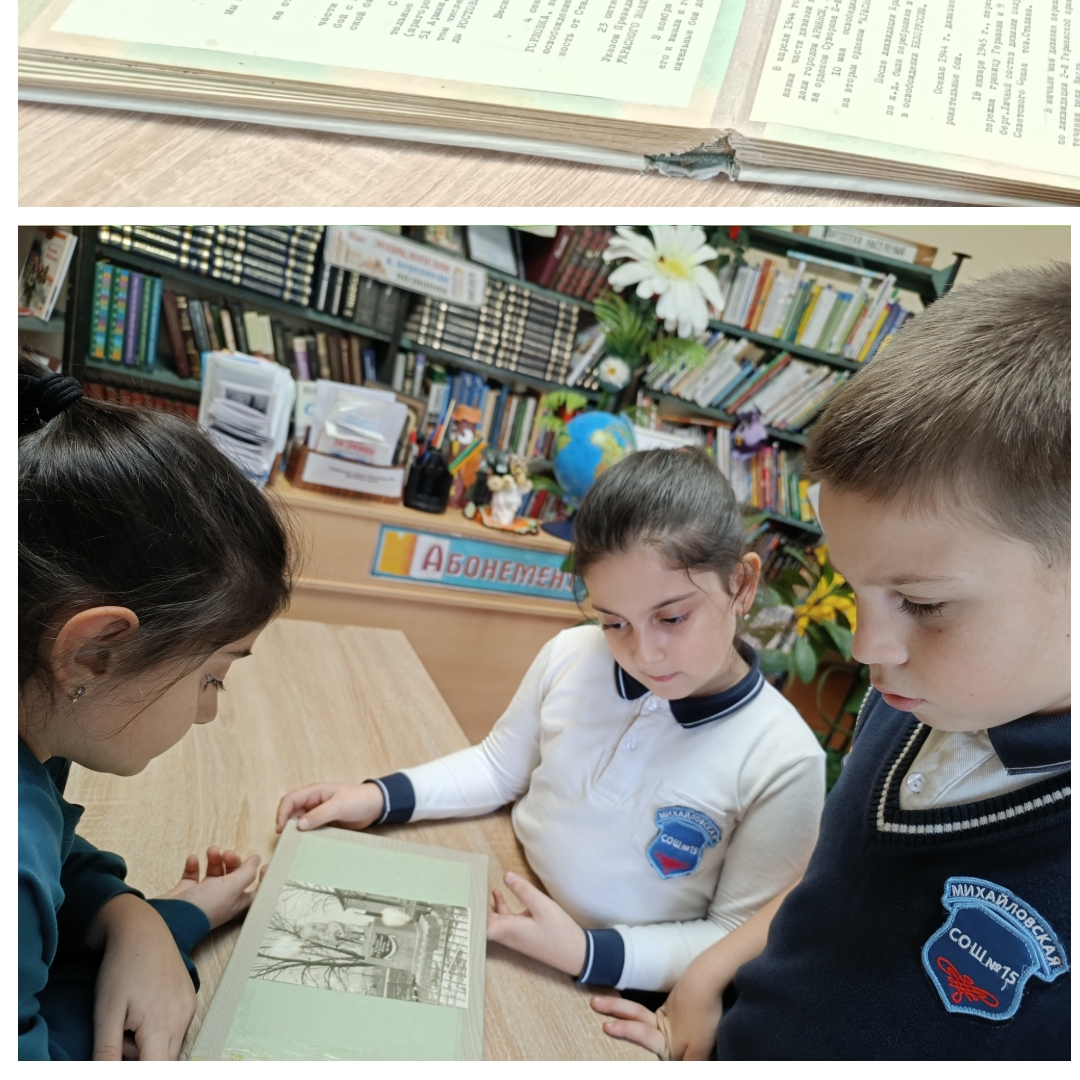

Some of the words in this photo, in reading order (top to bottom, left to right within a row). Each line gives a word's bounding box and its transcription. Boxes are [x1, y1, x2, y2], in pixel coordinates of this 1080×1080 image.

[316, 1, 339, 26] части
[331, 13, 349, 29] бой
[346, 10, 367, 31] ской
[388, 1, 415, 35] тельные
[435, 25, 450, 41] том
[557, 31, 575, 57] ность
[600, 32, 621, 62] Указом
[672, 28, 694, 71] нительные
[687, 10, 700, 26] бои
[775, 32, 791, 62] апреля
[821, 14, 839, 51] Суворова
[880, 12, 897, 57] ликвидации
[781, 71, 796, 98] ниями
[790, 38, 804, 64] части
[797, 4, 813, 37] дивизии
[802, 41, 819, 77] городом
[835, 46, 847, 63] мая
[843, 63, 858, 93] вторым
[851, 27, 866, 60] орденом
[952, 51, 962, 70] бои.
[1004, 50, 1015, 79] состав
[813, 53, 830, 88] орденом
[874, 58, 888, 84] После
[901, 51, 919, 108] освобождении
[933, 65, 946, 95] Осенью
[988, 57, 1001, 90] границу
[796, 79, 810, 100] дели
[945, 72, 960, 125] ронительные
[1014, 88, 1026, 139] Советского
[1072, 111, 1080, 147] течения
[659, 810, 719, 840] МИХАЙЛОВСКАЯ
[952, 884, 1061, 966] МИХАЙЛОВСКАЯ
